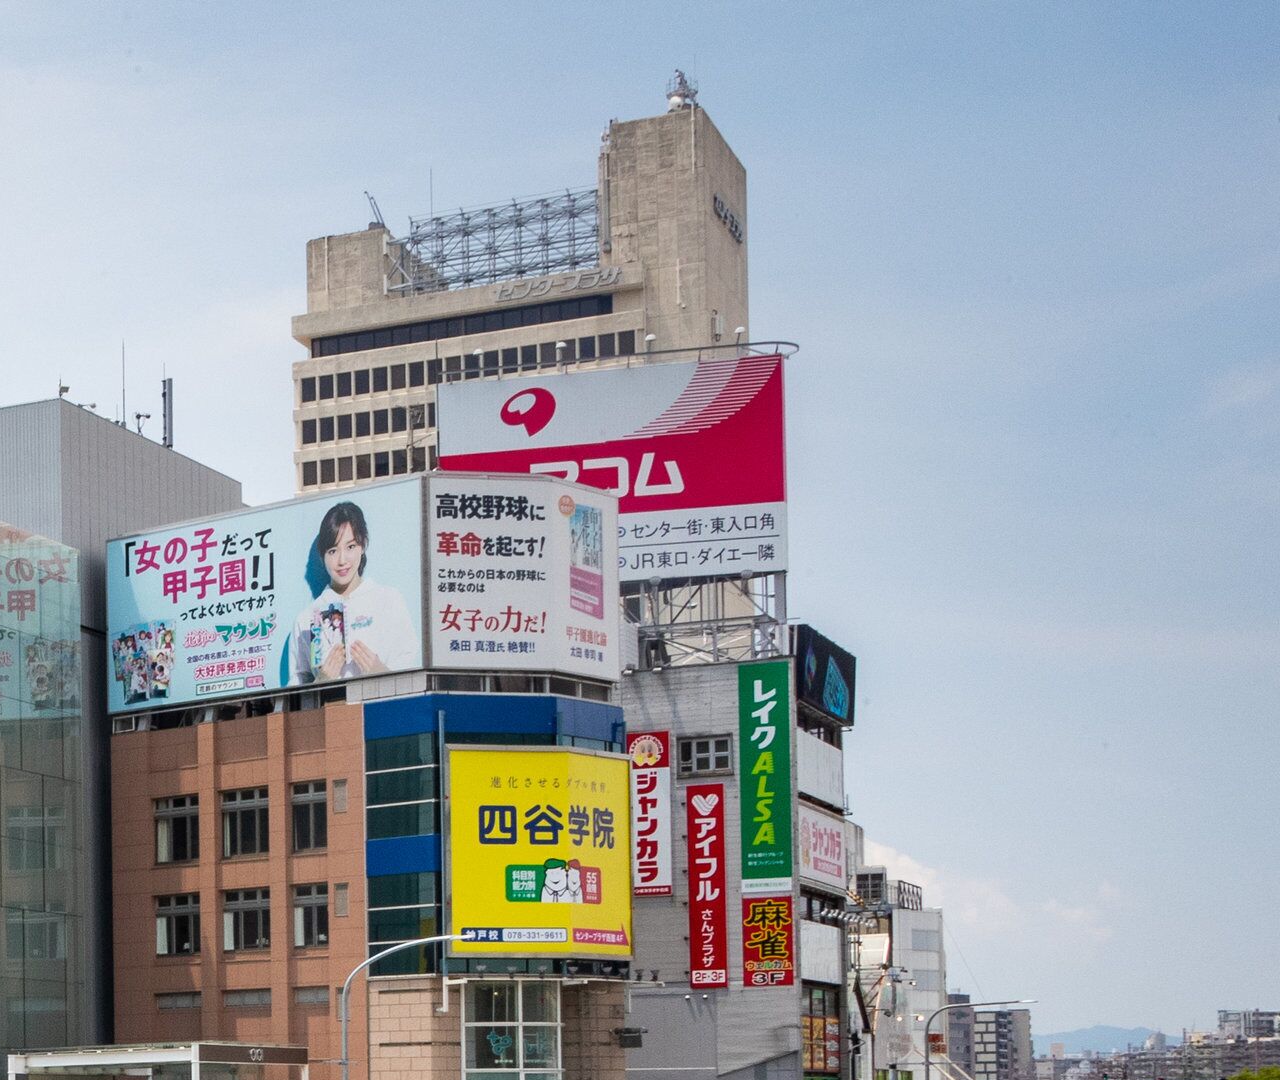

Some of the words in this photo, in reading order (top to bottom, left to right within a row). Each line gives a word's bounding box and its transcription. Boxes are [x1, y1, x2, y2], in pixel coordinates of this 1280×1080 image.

[496, 266, 623, 301] センタープラザ
[436, 494, 546, 521] 高校野球に
[630, 513, 776, 540] センター街・東入口角
[125, 527, 272, 577] 「女の子だって
[437, 532, 546, 558] 革命を起こす!
[630, 544, 776, 571] JR東口・ダイエー隣
[162, 552, 275, 604] 甲子園!」
[438, 568, 546, 582] これからの日本の野球に
[438, 582, 486, 594] 必要なのは
[180, 594, 275, 622] ってよくないですか?
[439, 603, 547, 635] 女子の力だ!
[449, 638, 471, 653] 桑田
[195, 657, 266, 681] 大好評発売中!!
[478, 803, 616, 850] 四谷学院
[636, 771, 659, 883] ジャンカラ
[694, 817, 721, 902] アイフル
[585, 871, 597, 884] 55
[507, 931, 564, 940] 078-331-9611
[744, 899, 792, 960] 麻雀
[751, 971, 786, 986] 3F
